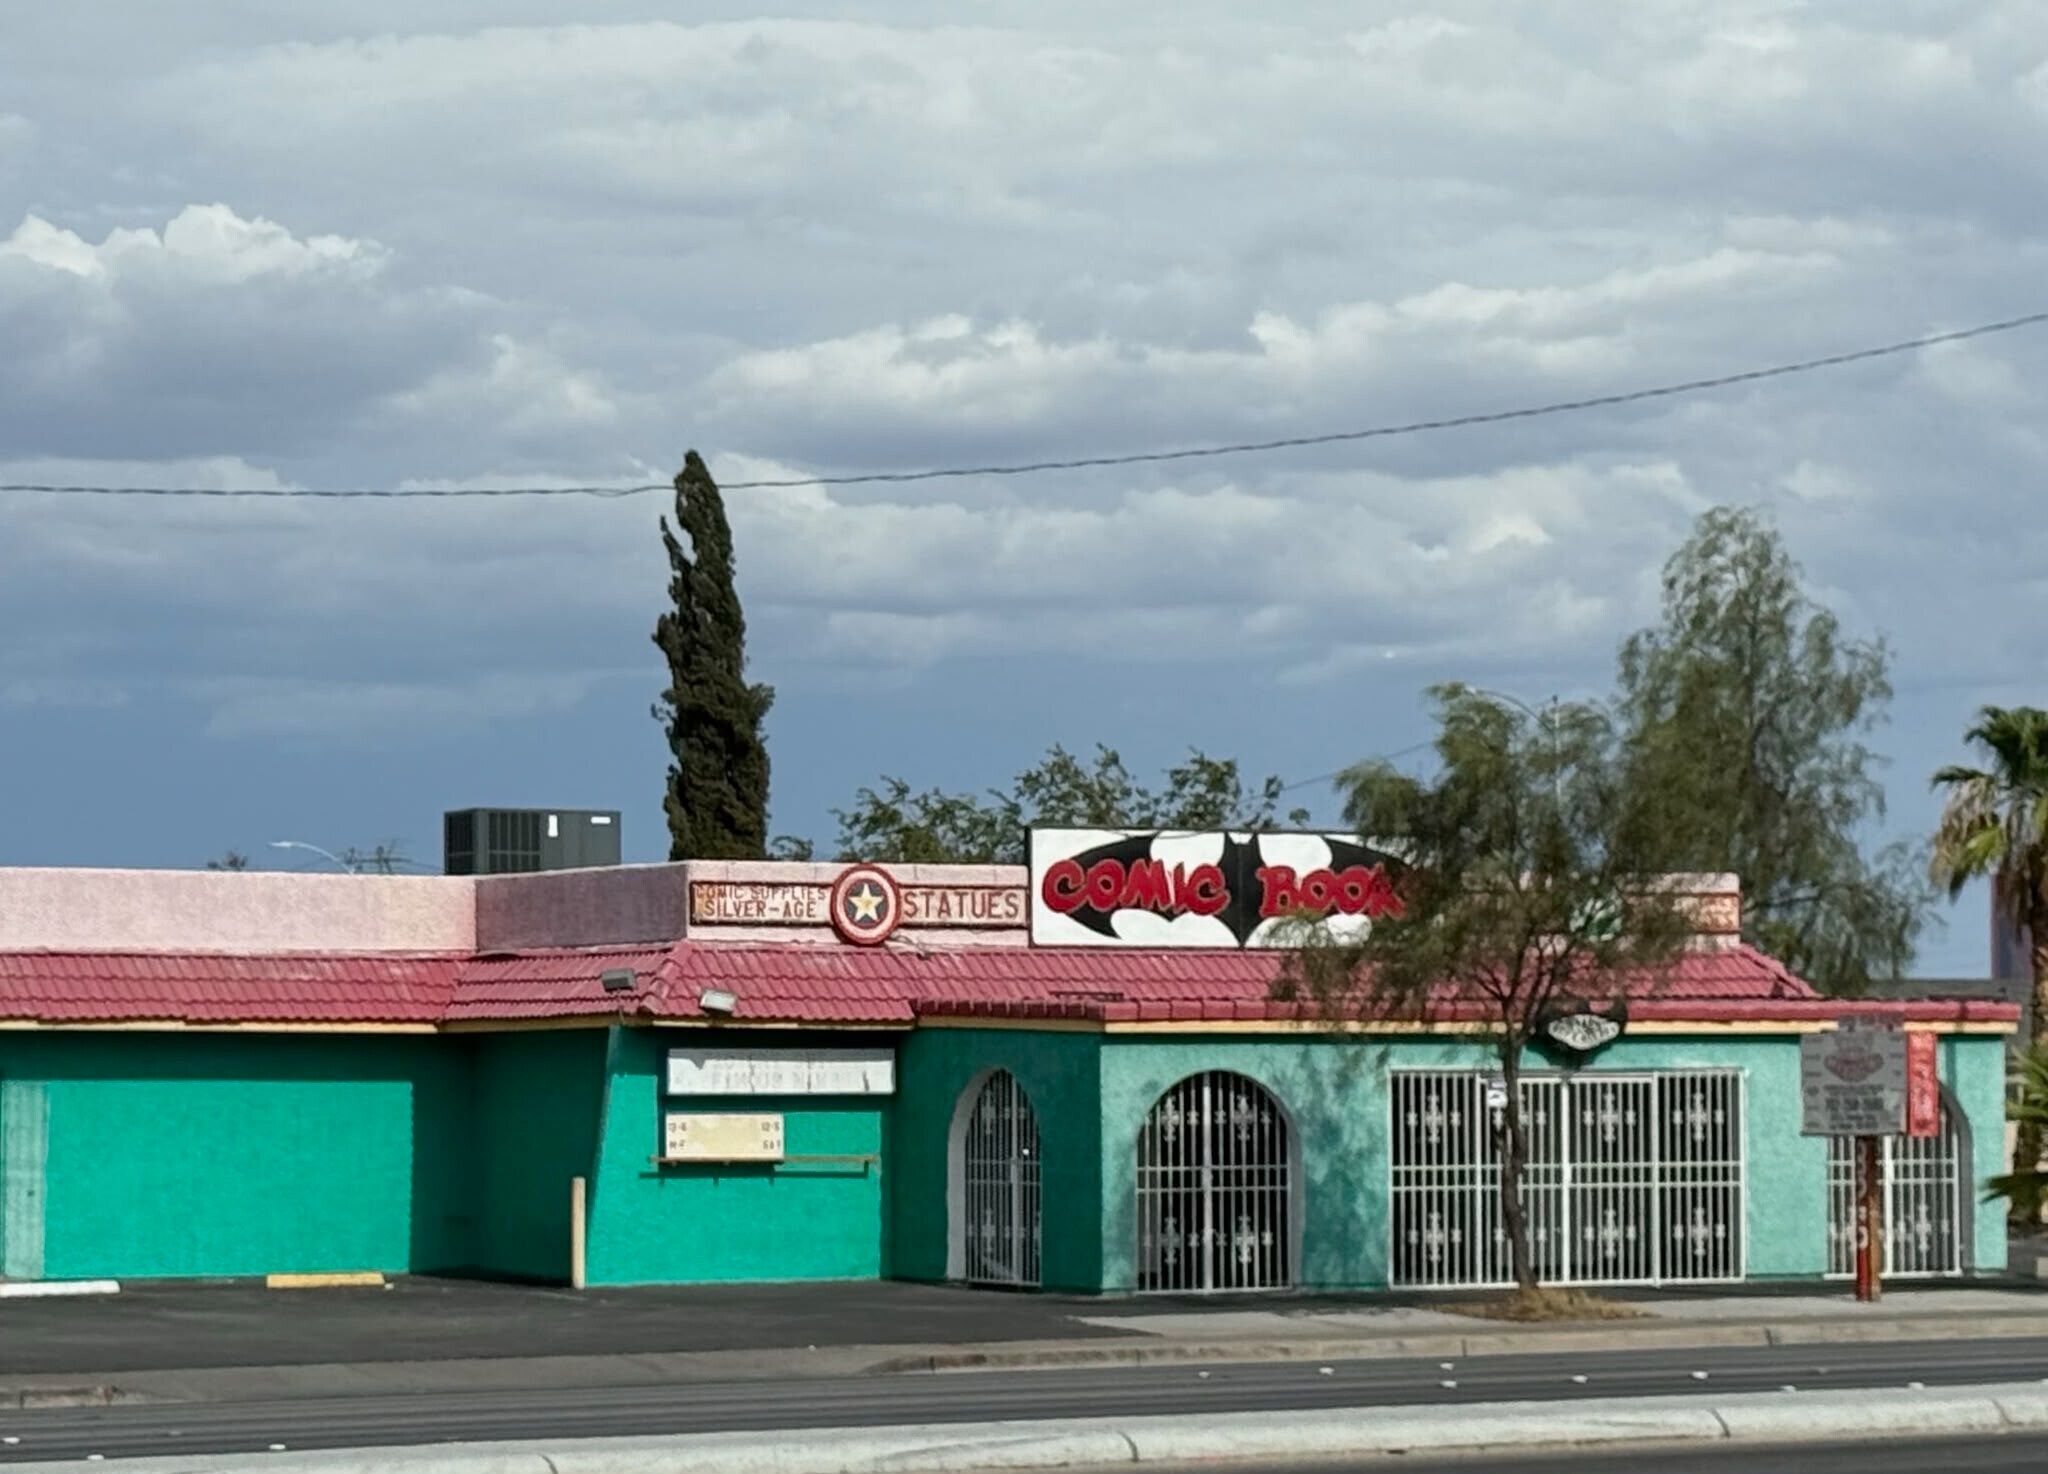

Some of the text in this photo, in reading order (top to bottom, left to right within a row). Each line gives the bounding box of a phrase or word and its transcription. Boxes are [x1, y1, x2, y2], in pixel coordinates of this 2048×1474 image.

[696, 885, 827, 901] COMIC SUPPLIES
[1042, 857, 1406, 918] COMIC BOOK
[703, 900, 817, 918] SILVER-AGE
[903, 890, 1019, 919] STATUES
